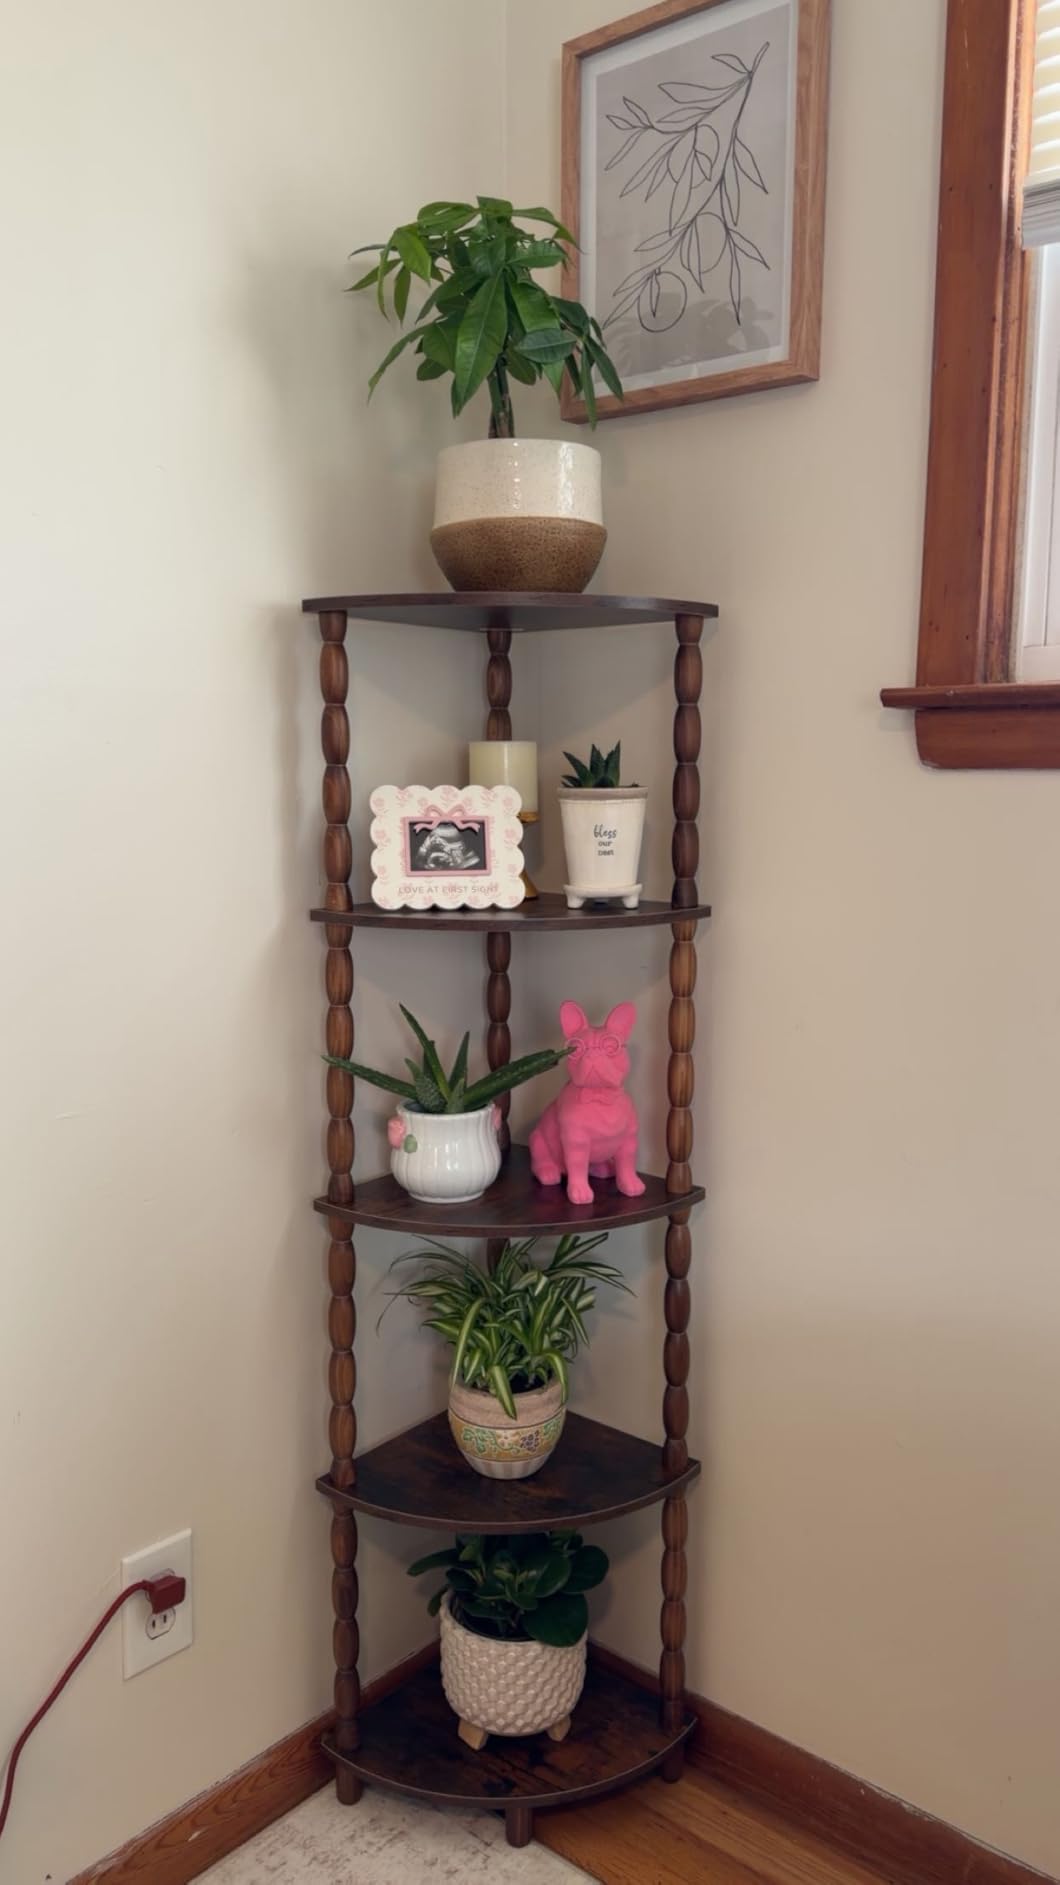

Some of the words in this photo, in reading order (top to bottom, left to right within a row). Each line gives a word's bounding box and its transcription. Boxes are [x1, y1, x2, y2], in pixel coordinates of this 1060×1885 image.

[593, 823, 617, 839] bless
[398, 886, 425, 895] LOVE
[426, 886, 439, 894] AT
[441, 885, 469, 894] FIRST
